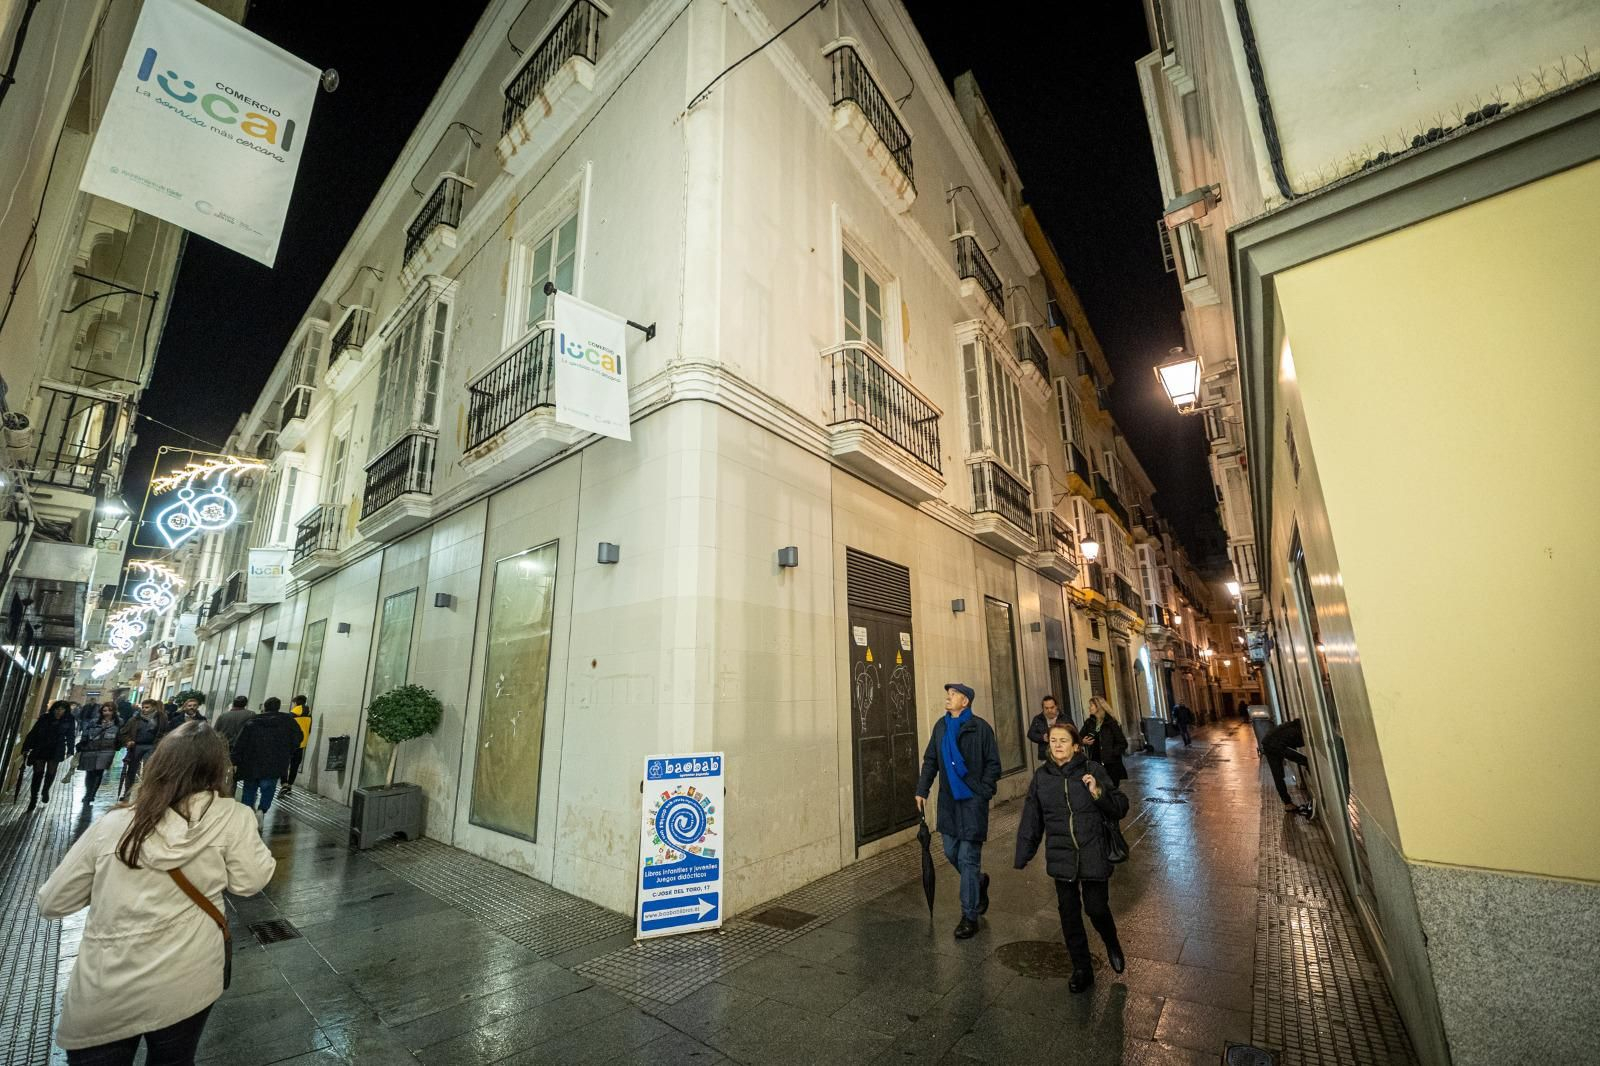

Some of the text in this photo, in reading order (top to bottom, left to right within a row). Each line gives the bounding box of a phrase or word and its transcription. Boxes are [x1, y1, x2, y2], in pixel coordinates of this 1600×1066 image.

[137, 47, 295, 152] local
[215, 82, 281, 118] COMERCIO
[135, 85, 151, 99] La
[155, 96, 207, 128] sonrisa
[236, 137, 285, 163] cercana
[560, 332, 622, 375] local
[665, 758, 719, 774] baobab
[645, 870, 662, 878] Libros
[694, 864, 718, 873] juveniles
